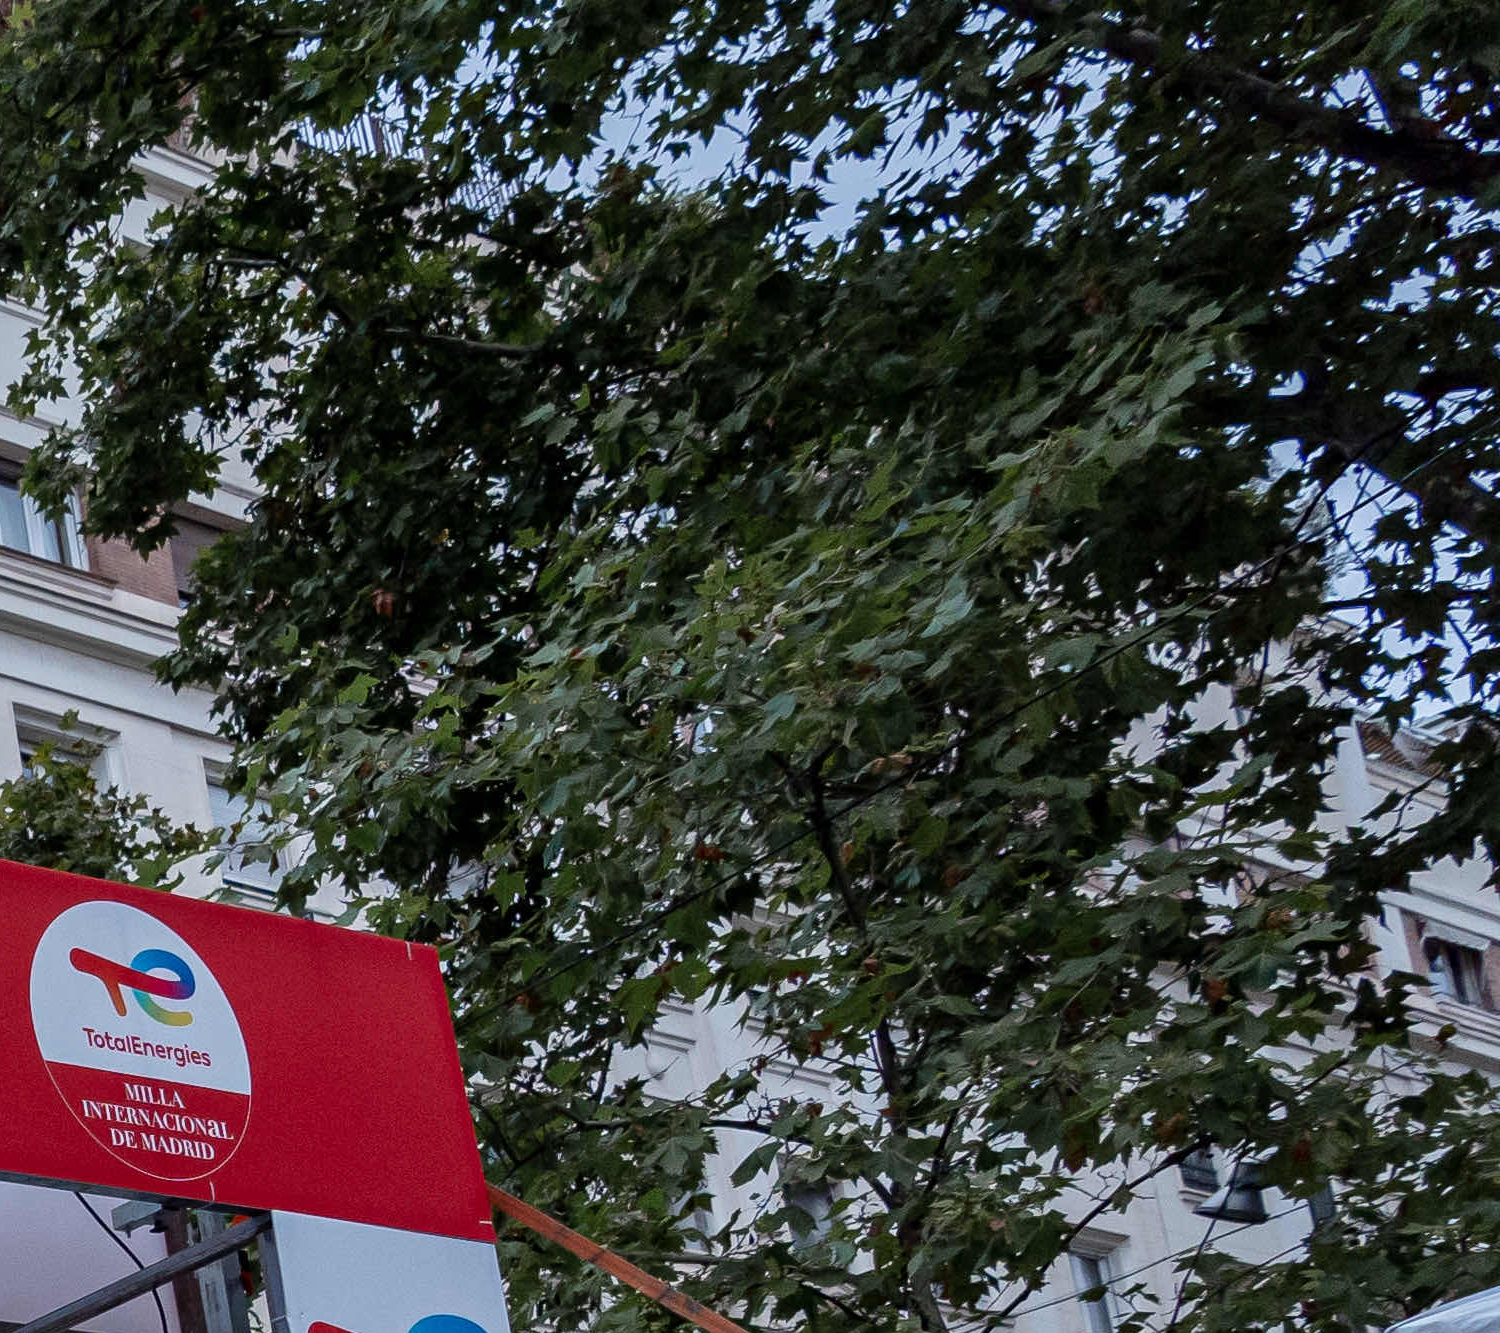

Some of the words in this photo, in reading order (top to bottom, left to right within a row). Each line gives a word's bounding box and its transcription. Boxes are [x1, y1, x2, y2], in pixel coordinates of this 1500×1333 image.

[82, 1027, 211, 1067] TotalEnergies
[124, 1082, 186, 1109] MILLA
[109, 1127, 138, 1149] DE
[139, 1132, 215, 1160] MADRID
